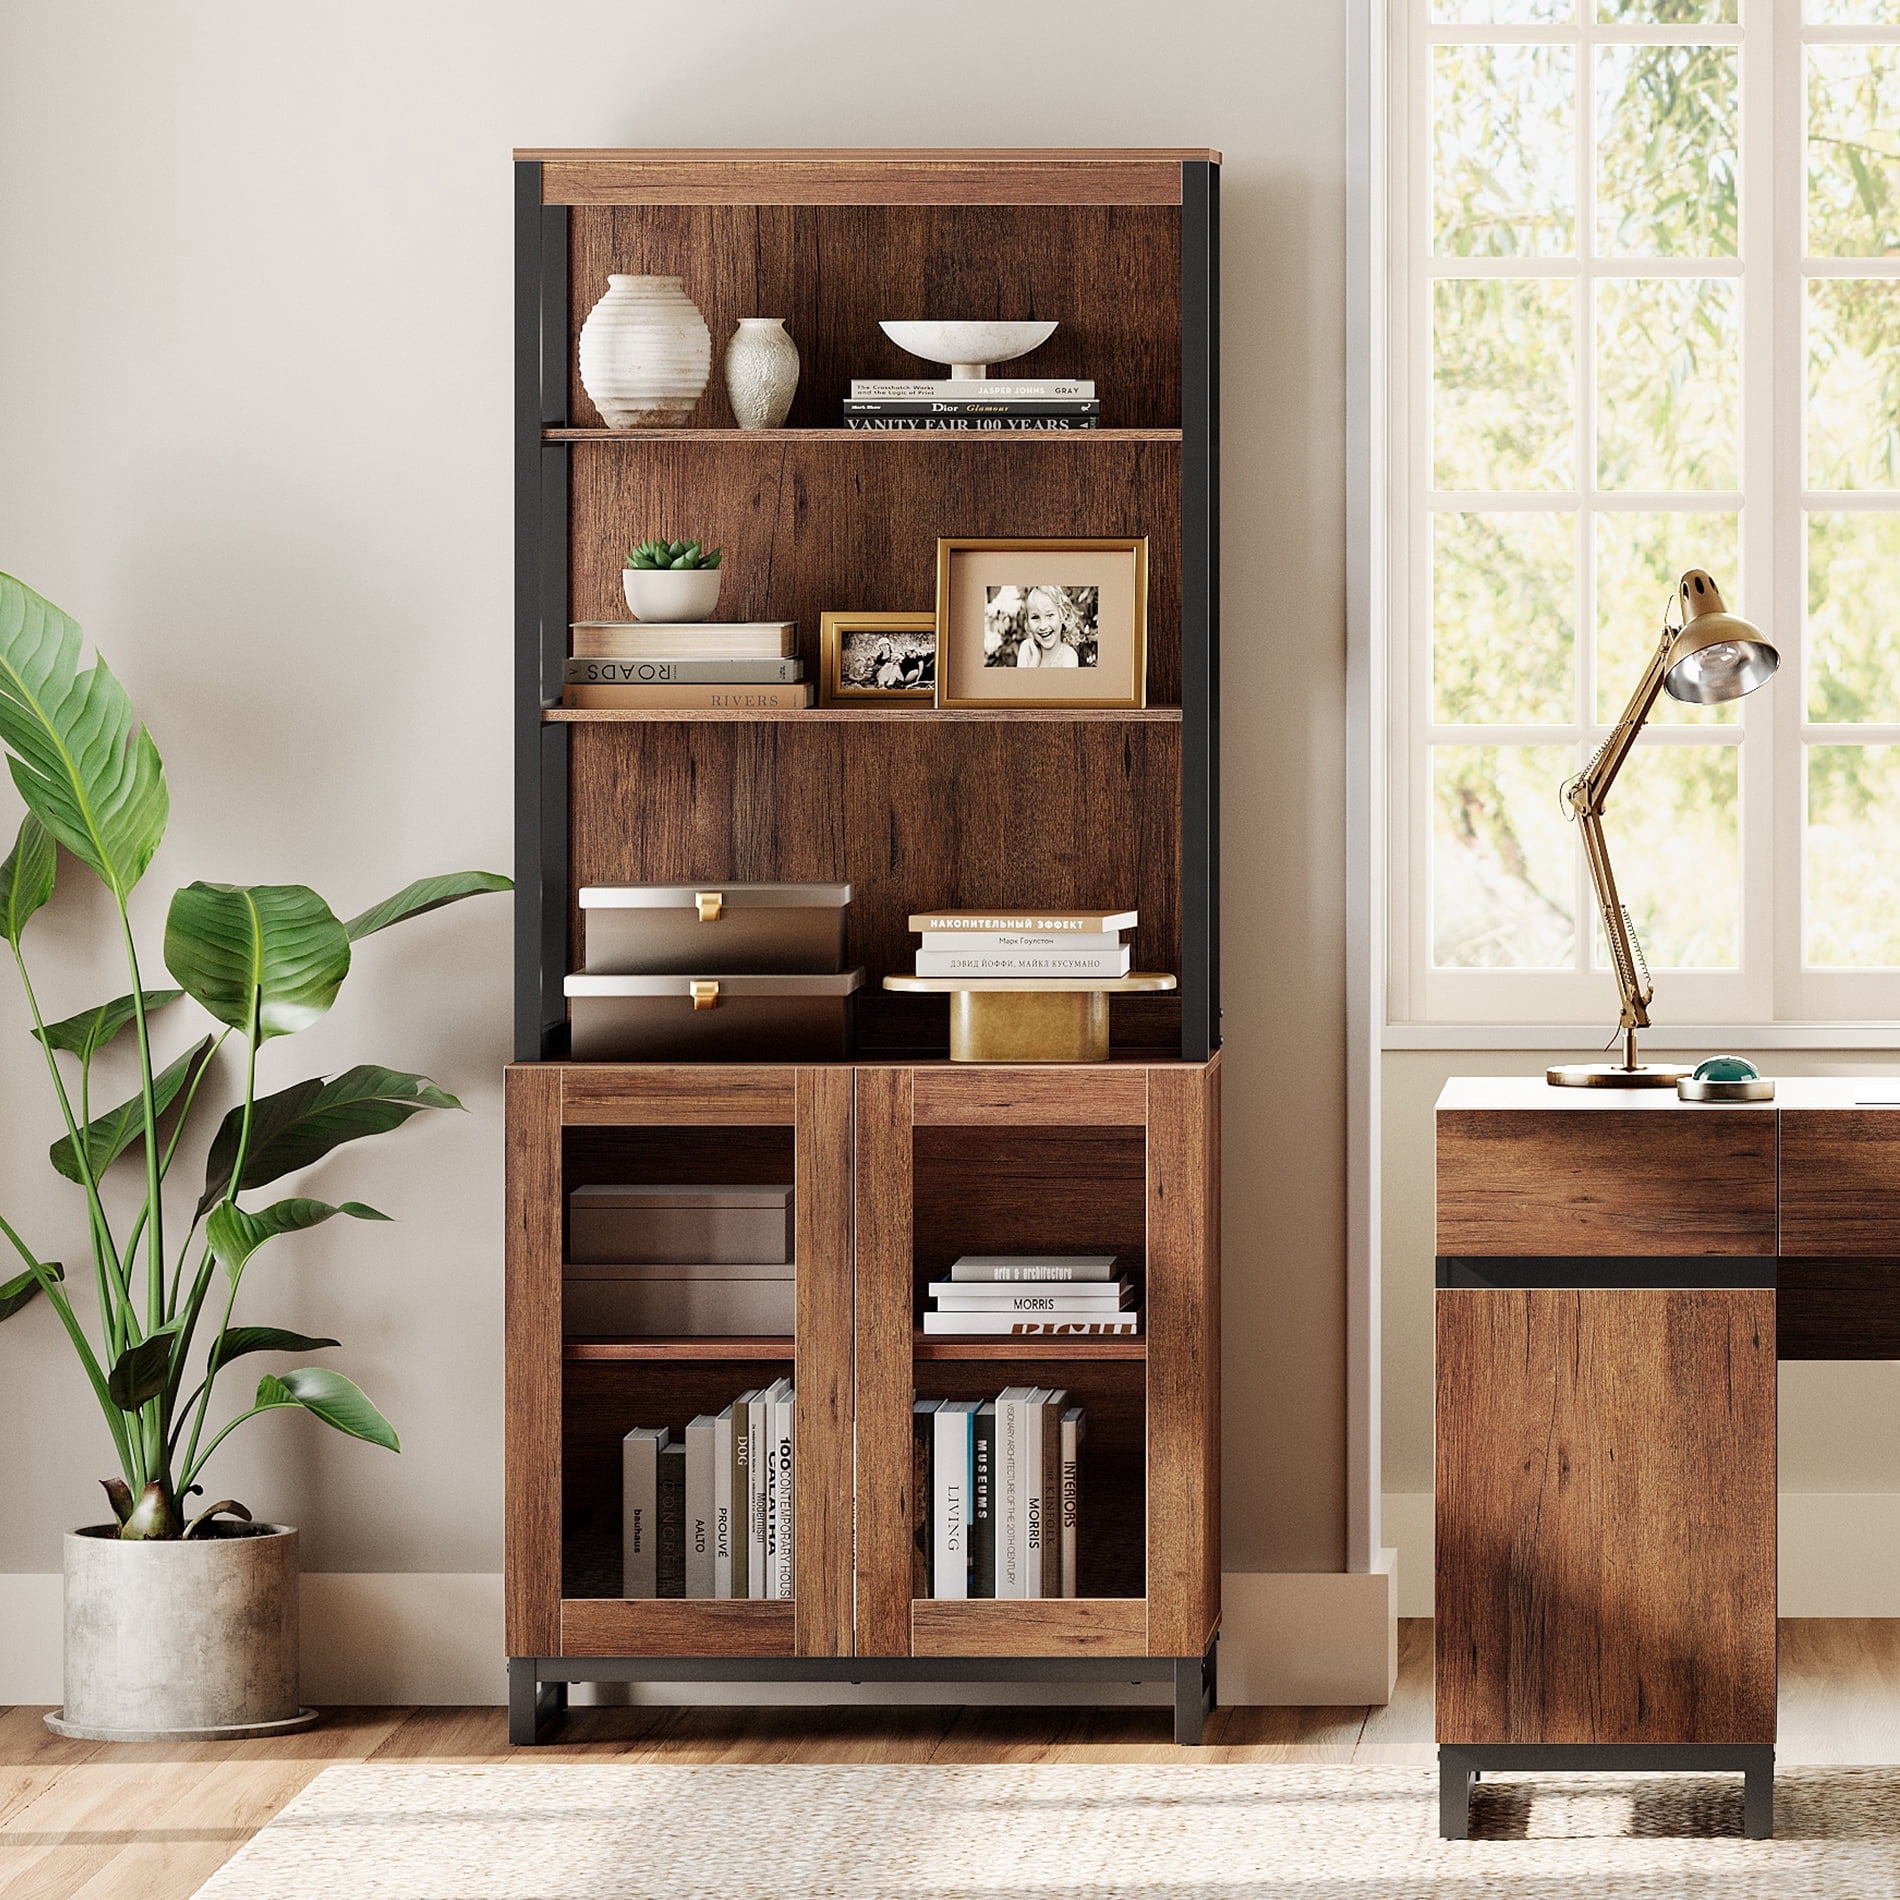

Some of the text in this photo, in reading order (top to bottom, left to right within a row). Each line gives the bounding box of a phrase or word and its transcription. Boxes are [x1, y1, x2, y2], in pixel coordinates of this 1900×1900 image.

[978, 387, 1045, 395] JASPER JOHNS
[932, 403, 1009, 412] Dior Glamour
[848, 419, 1069, 430] VANITY FAIR 100 YEARS
[588, 664, 670, 680] ROADS
[711, 695, 779, 706] RIVERS
[930, 918, 1084, 929] НАКОПИТЕЛЬНЫЙ ЭФФЕКТ
[999, 937, 1054, 946] Марк Гоулстон
[950, 957, 1100, 969] ДЭВИД ЙОФФИ, МАЙКЛ КУСУМАНО
[994, 1267, 1011, 1280] arts
[1023, 1266, 1073, 1280] architecture
[1013, 1299, 1054, 1310] MORRIS
[737, 1434, 748, 1466] DOG
[977, 1440, 988, 1519] MUSEUMS
[1007, 1403, 1015, 1585] VISIONARY ARCHITECTURE OF THE 20TH CENTURY
[1064, 1461, 1075, 1528] INTERIORS
[633, 1509, 642, 1553] bauhaus
[718, 1507, 728, 1558] PROUVÉ
[756, 1492, 767, 1543] Modernism
[948, 1486, 959, 1551] LIVING
[1029, 1498, 1039, 1549] MORRIS
[695, 1519, 705, 1553] AALTO
[780, 1565, 791, 1599] HOUS
